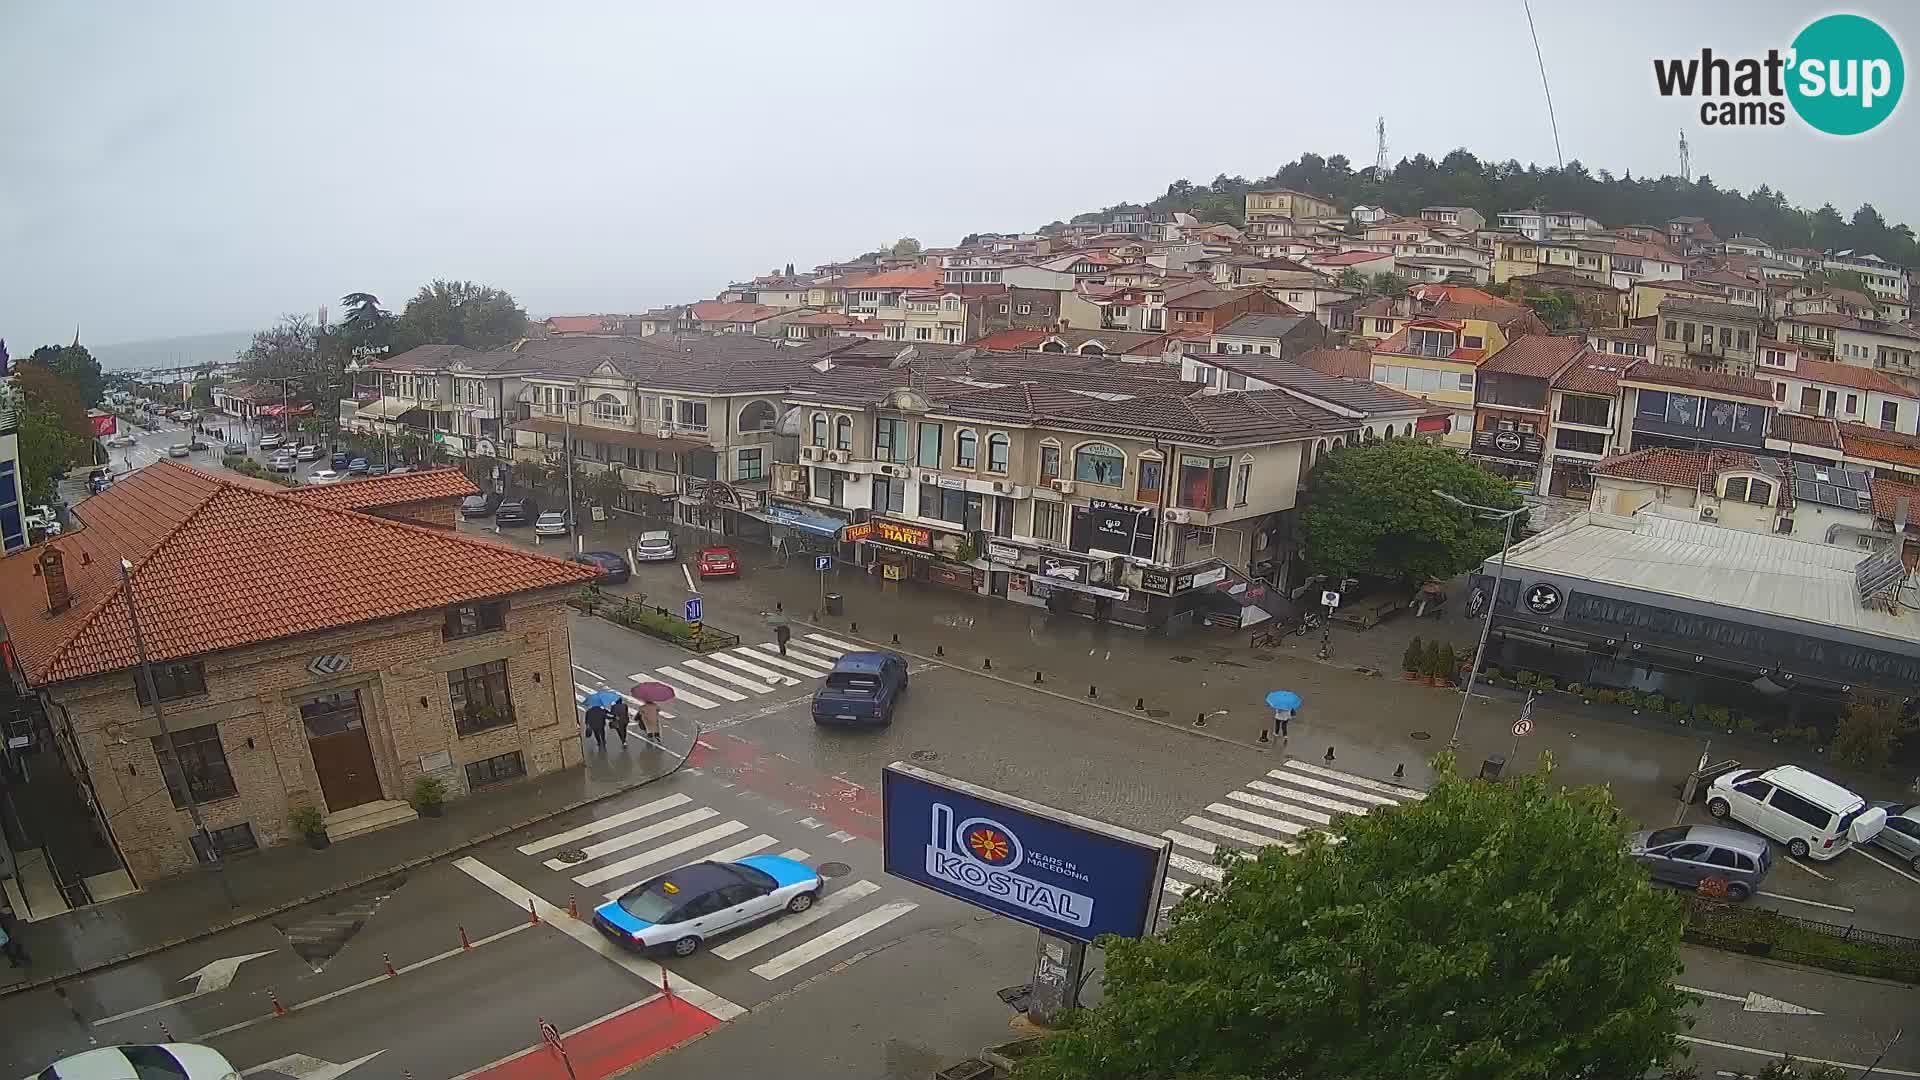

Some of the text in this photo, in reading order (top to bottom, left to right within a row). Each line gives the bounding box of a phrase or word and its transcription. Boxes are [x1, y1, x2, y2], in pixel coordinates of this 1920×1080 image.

[884, 529, 917, 544] HARI
[1027, 849, 1077, 871] YEARS IN
[1027, 857, 1090, 883] MACEDONIA
[935, 851, 1080, 921] KOSTAL
